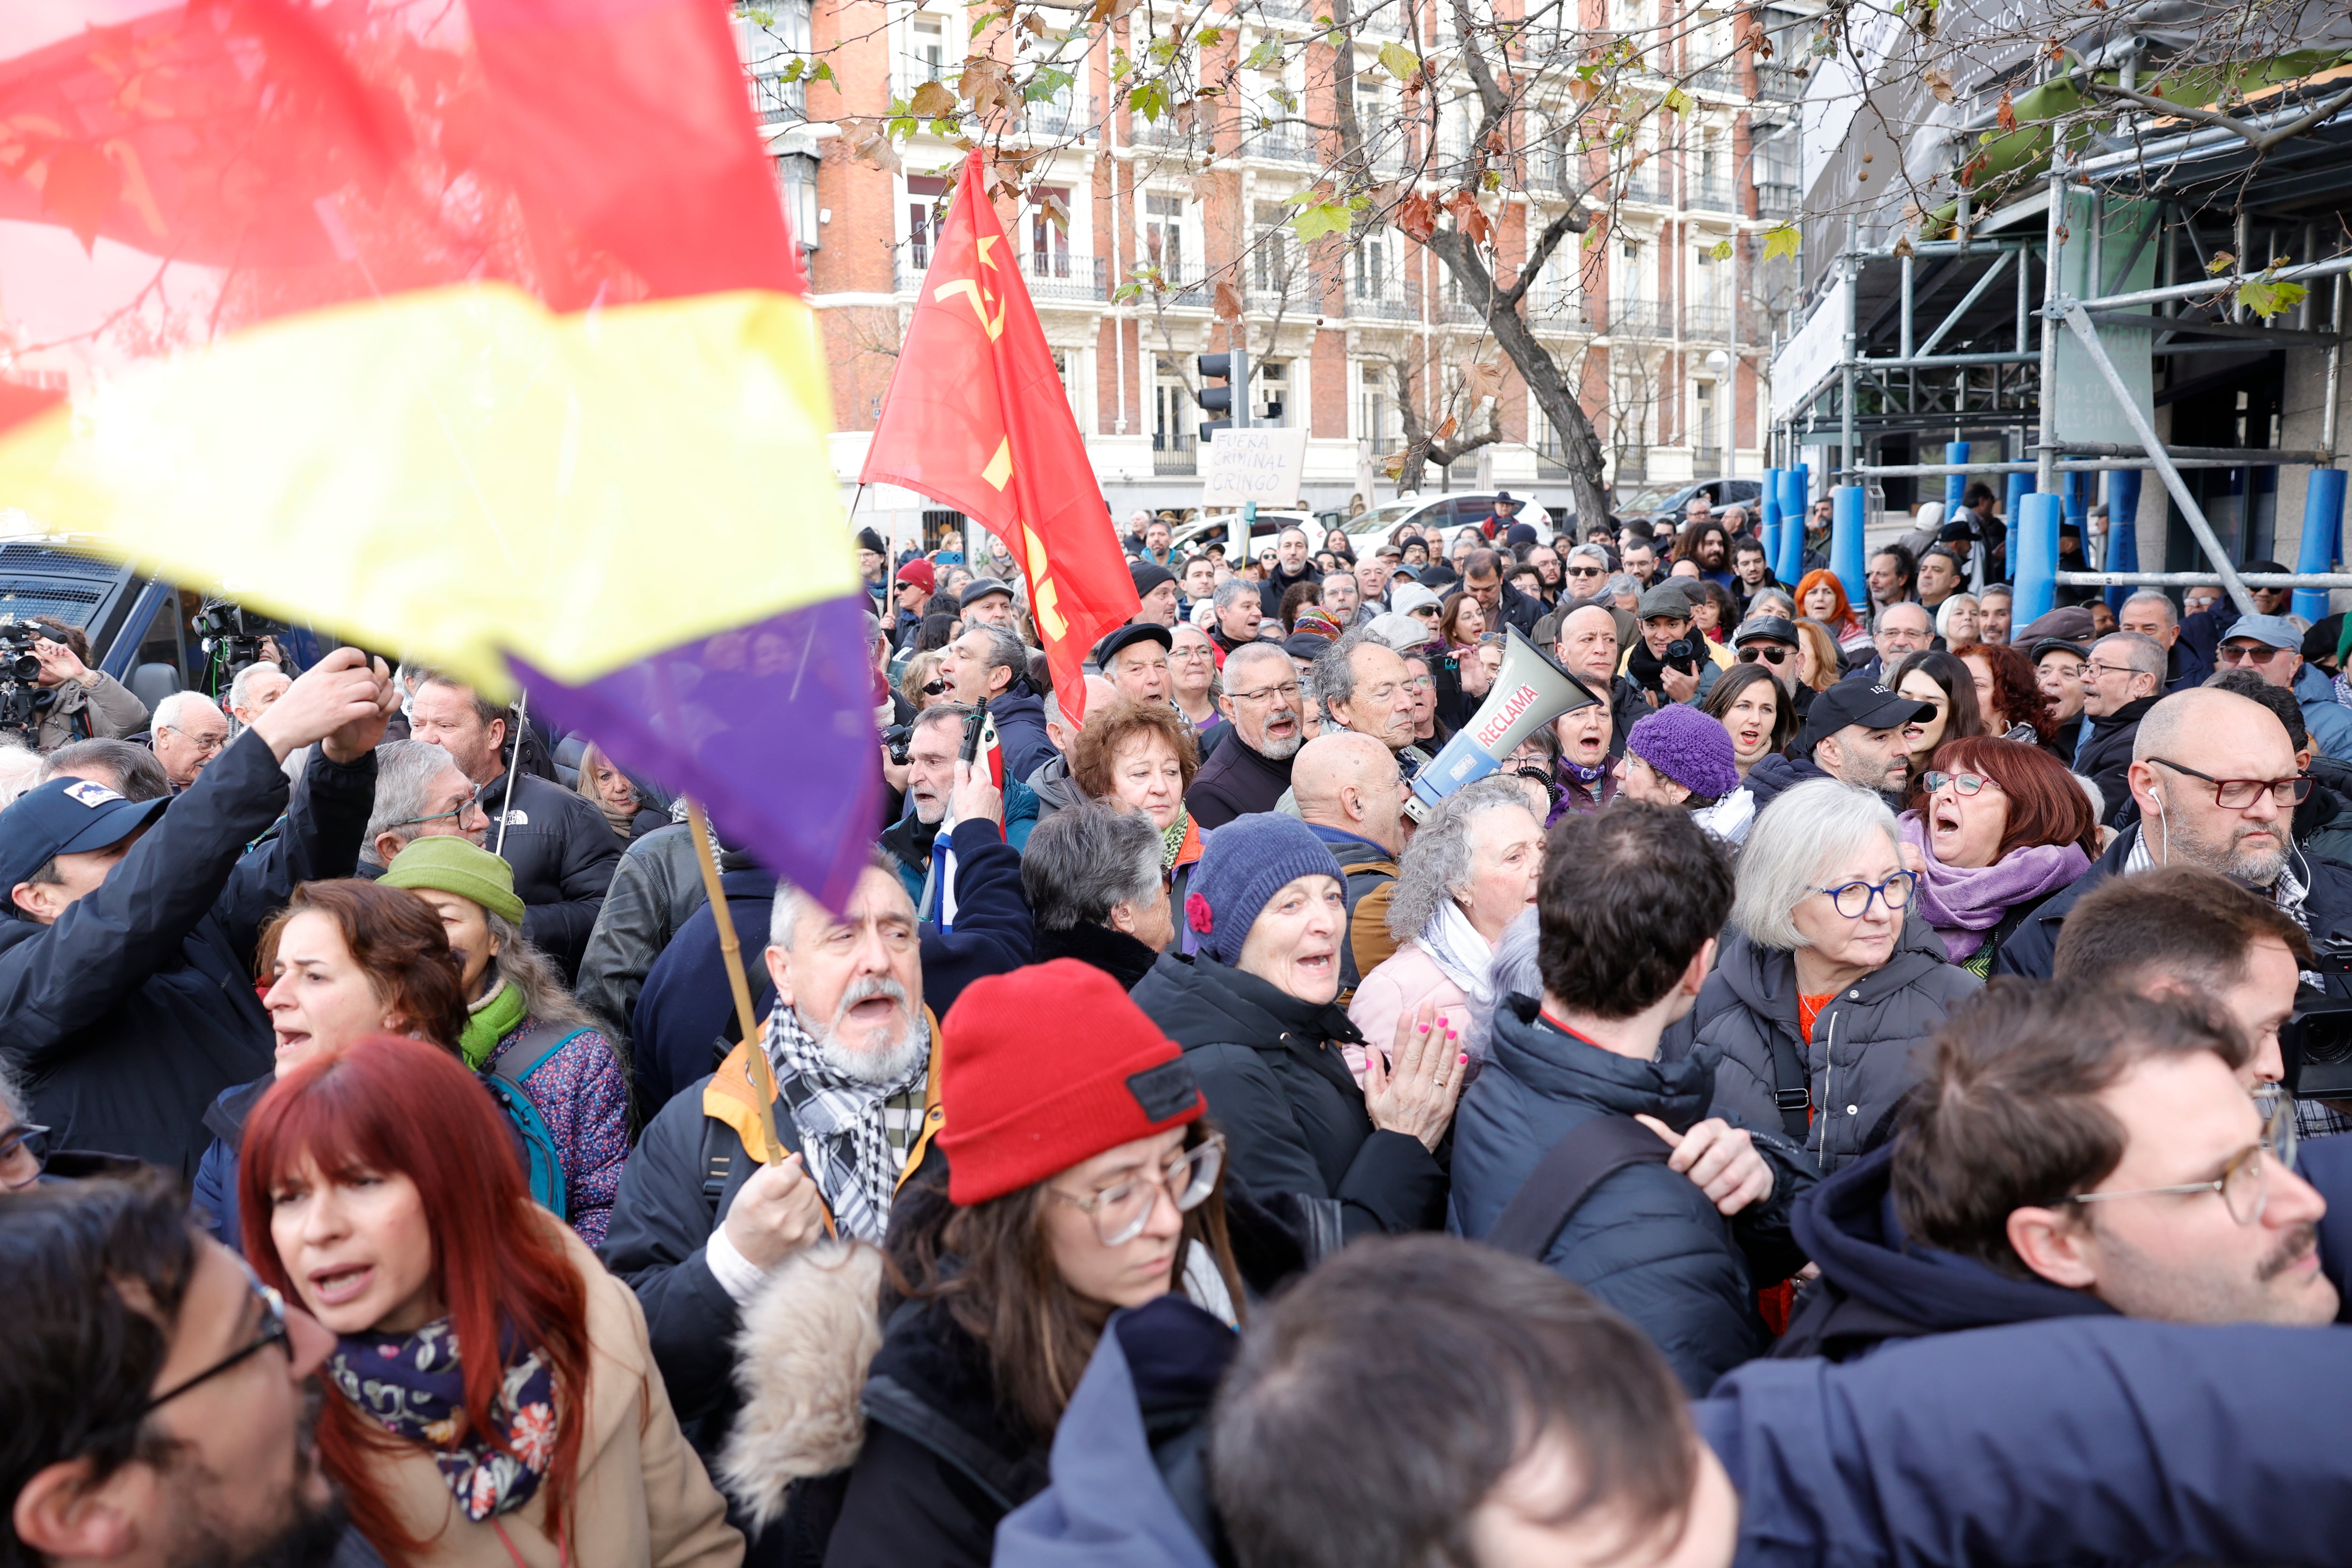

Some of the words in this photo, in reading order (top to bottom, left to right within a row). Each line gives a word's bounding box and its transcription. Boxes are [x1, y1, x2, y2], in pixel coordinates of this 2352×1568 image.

[1217, 434, 1268, 450] FUERA
[1214, 449, 1286, 470] CRIMINAL
[1213, 470, 1279, 491] GRINGO
[1477, 686, 1539, 748] RECLAMA
